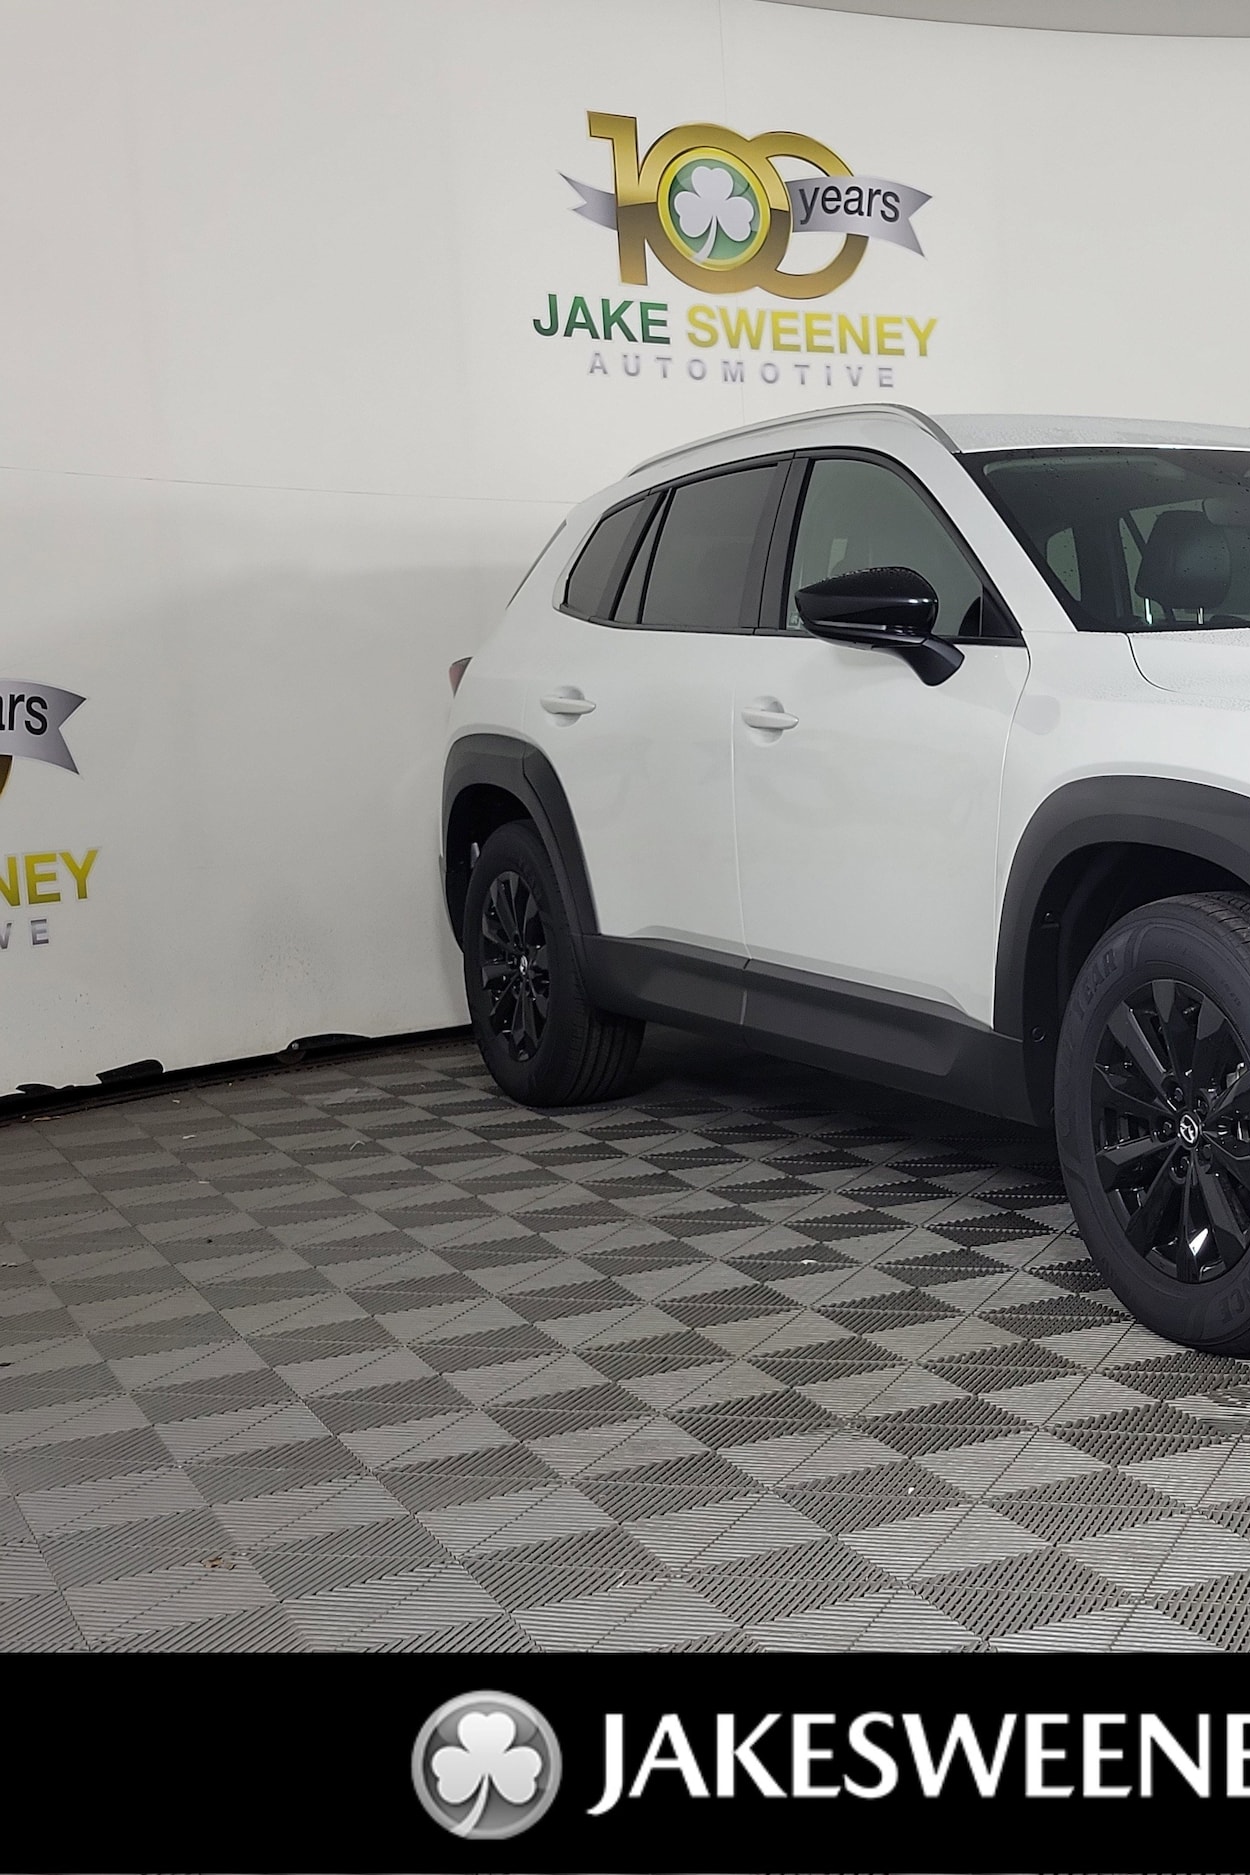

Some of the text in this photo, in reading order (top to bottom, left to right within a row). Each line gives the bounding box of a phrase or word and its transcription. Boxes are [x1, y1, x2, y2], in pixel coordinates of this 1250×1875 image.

[586, 110, 901, 299] 100 years
[532, 293, 938, 357] JAKE SWEENEY
[588, 352, 895, 388] AUTOMOTIVE
[0, 694, 48, 735] rs
